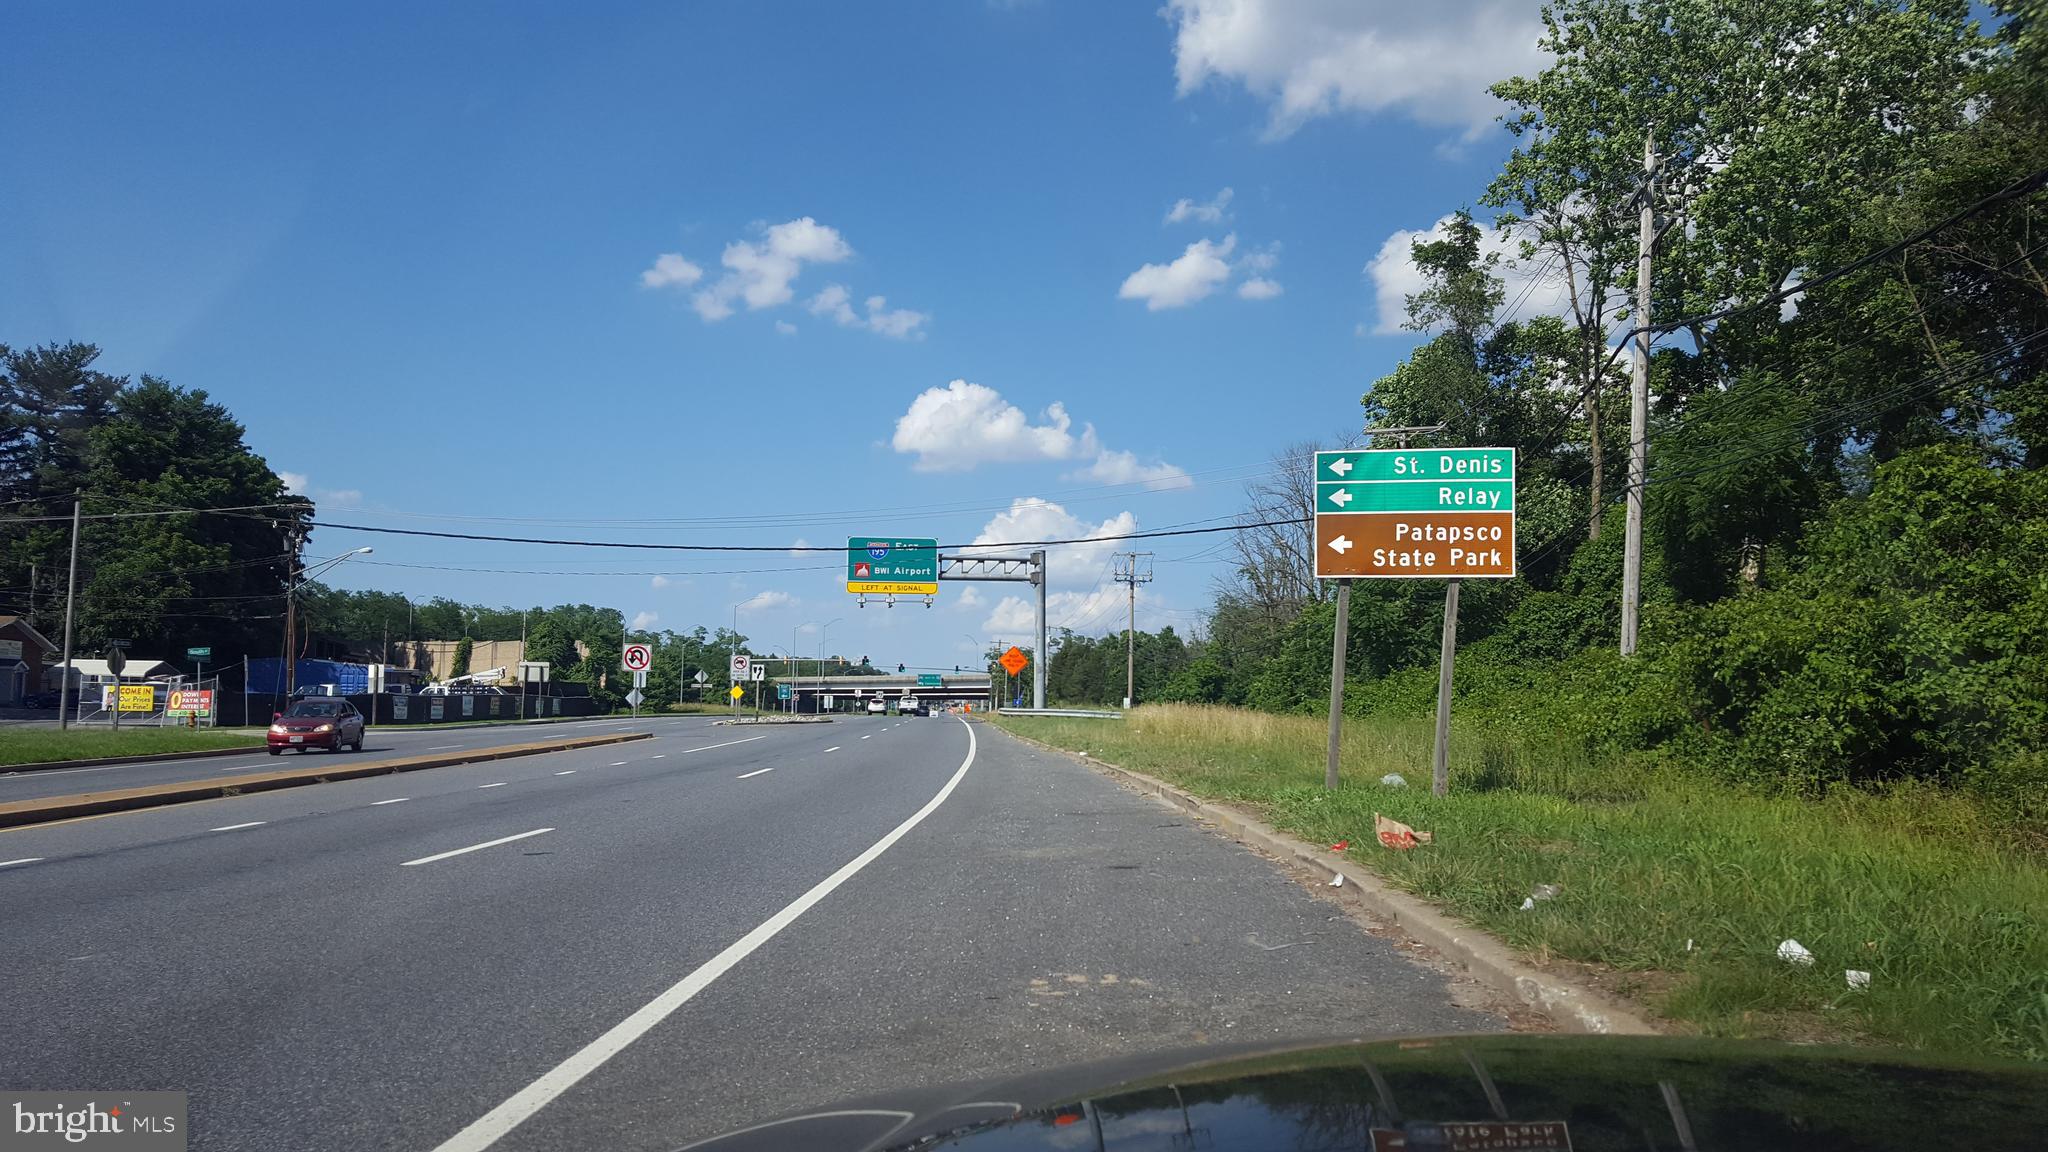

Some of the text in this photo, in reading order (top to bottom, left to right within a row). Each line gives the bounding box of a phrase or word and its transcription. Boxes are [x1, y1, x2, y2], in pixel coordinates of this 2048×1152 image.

[1393, 455, 1502, 474] St. Denis
[1439, 487, 1501, 509] Relay
[1395, 523, 1502, 544] Patapsco
[1373, 548, 1502, 567] State Park
[894, 567, 931, 576] Airport
